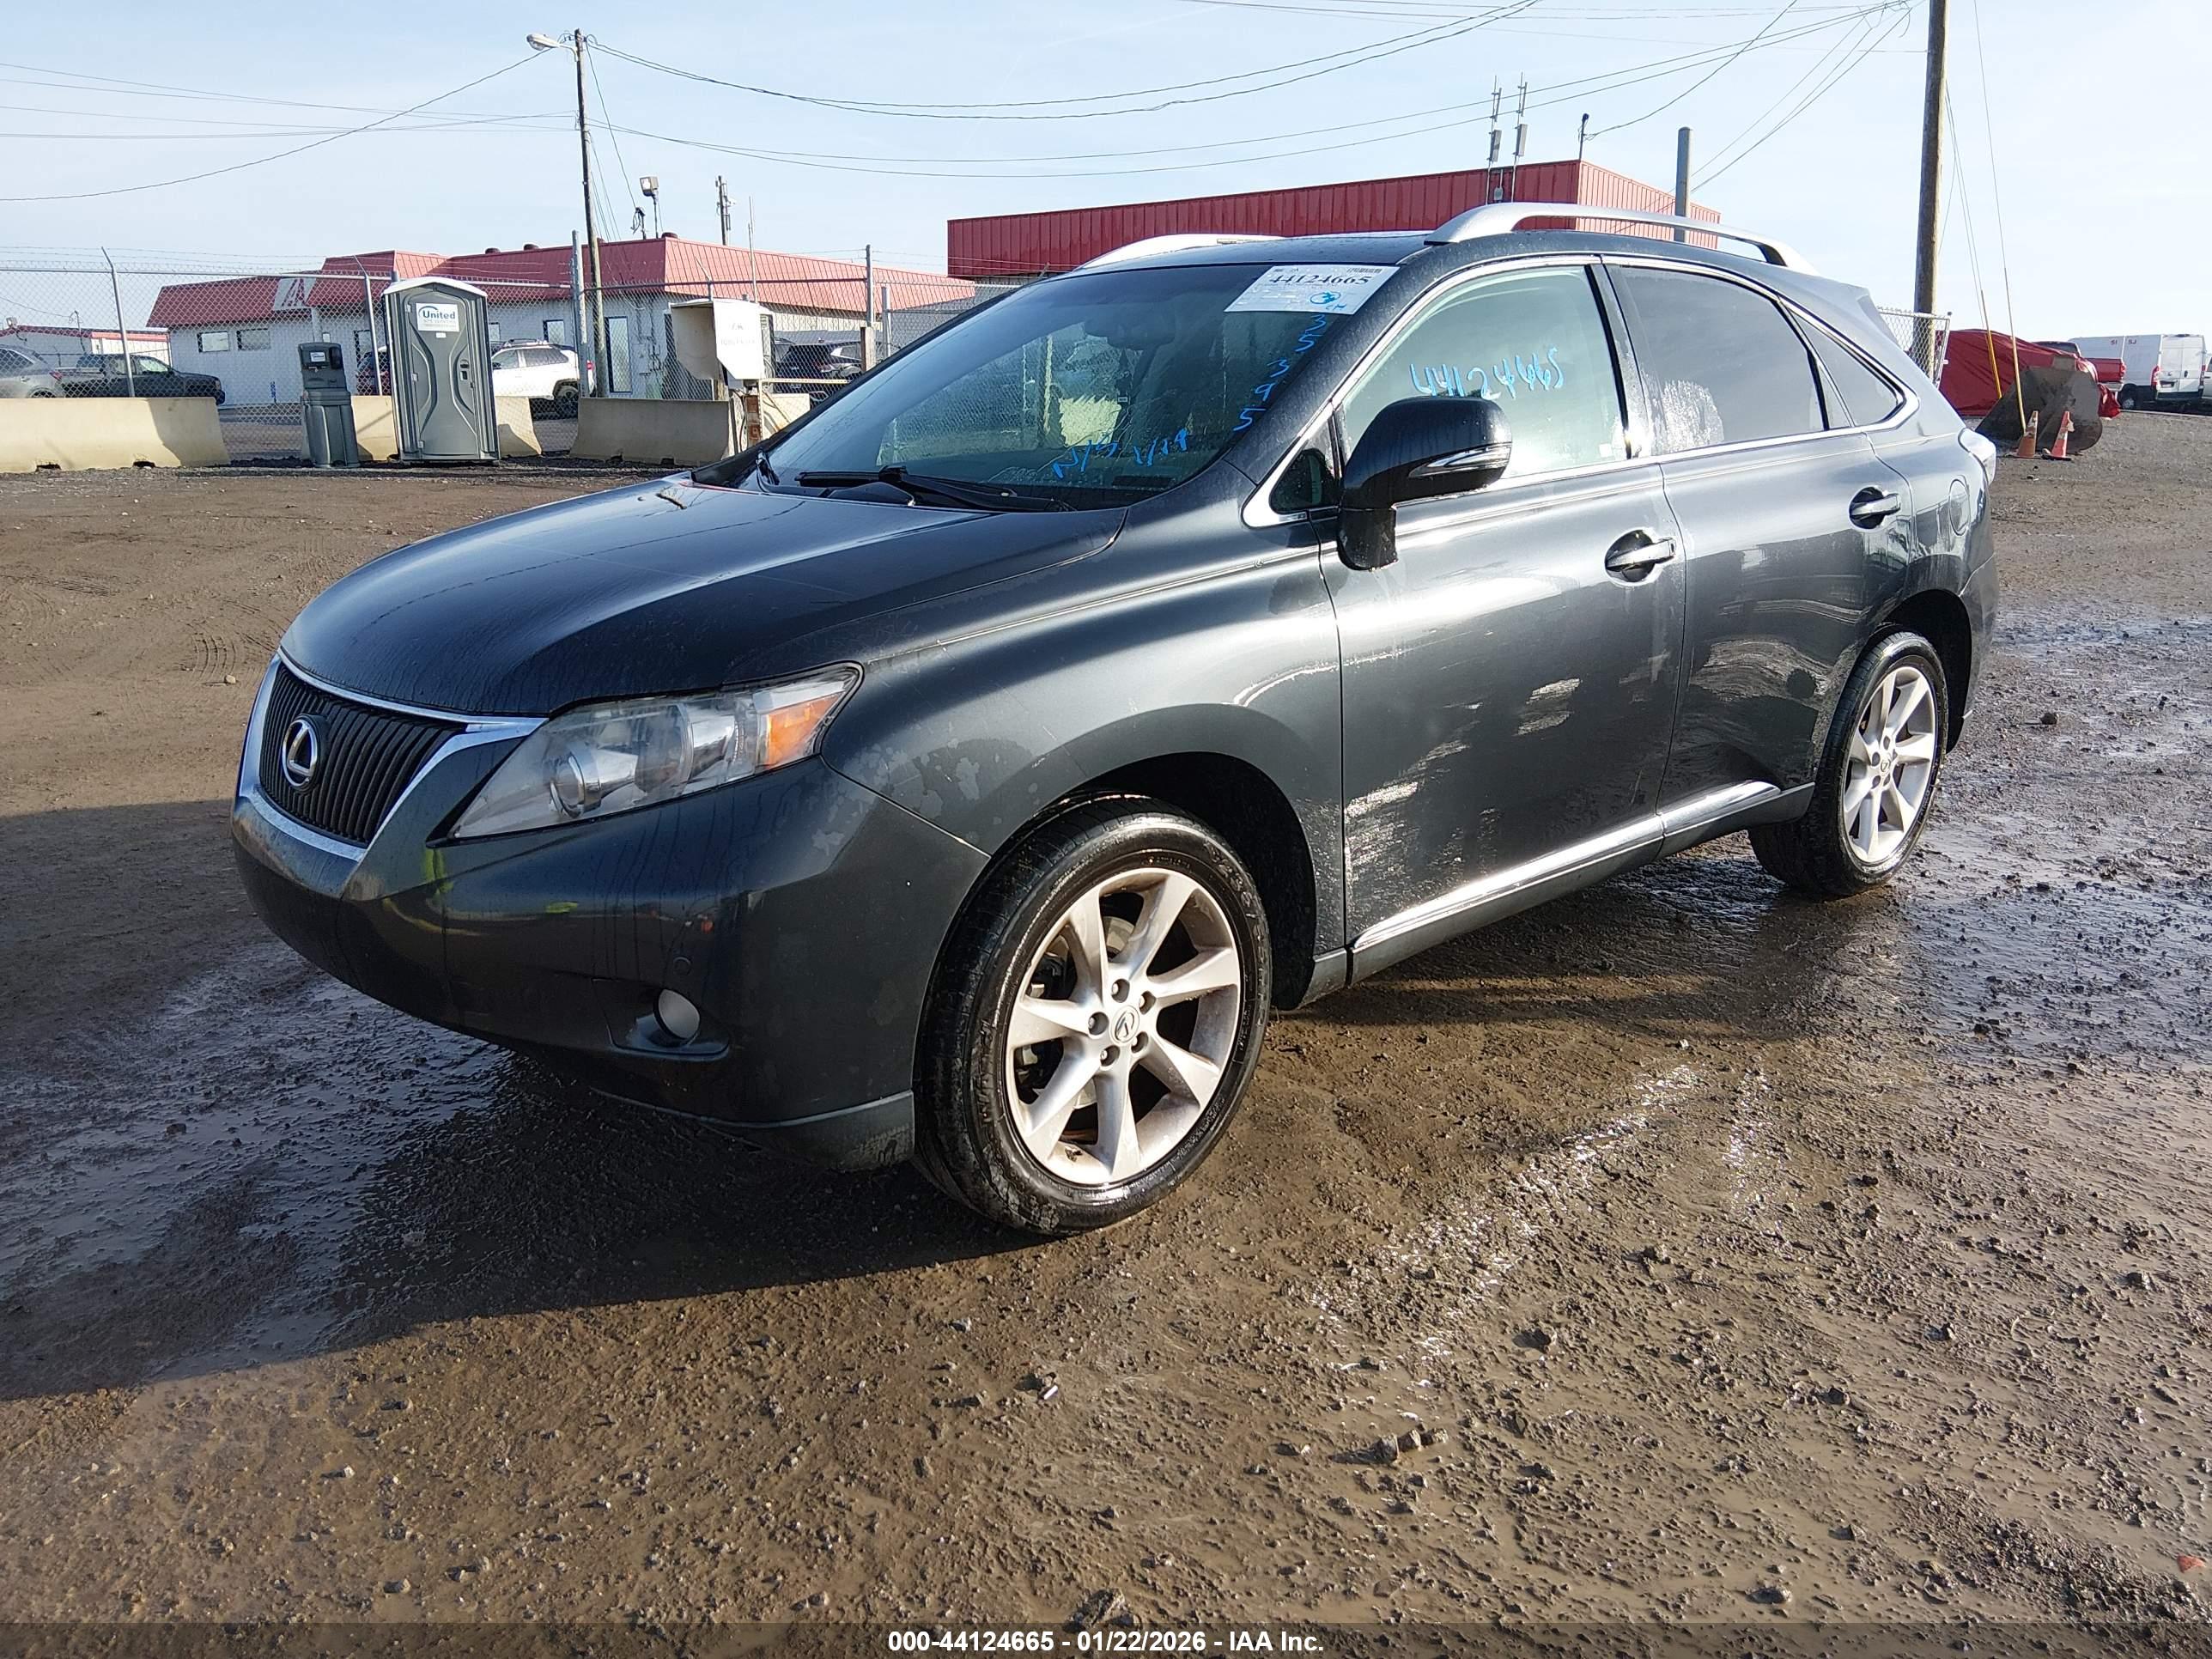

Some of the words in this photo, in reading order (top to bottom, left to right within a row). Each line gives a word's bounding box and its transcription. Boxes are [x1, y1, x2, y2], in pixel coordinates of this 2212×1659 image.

[1269, 274, 1373, 285] 44124665
[422, 310, 456, 319] United
[1409, 343, 1564, 399] 44124665
